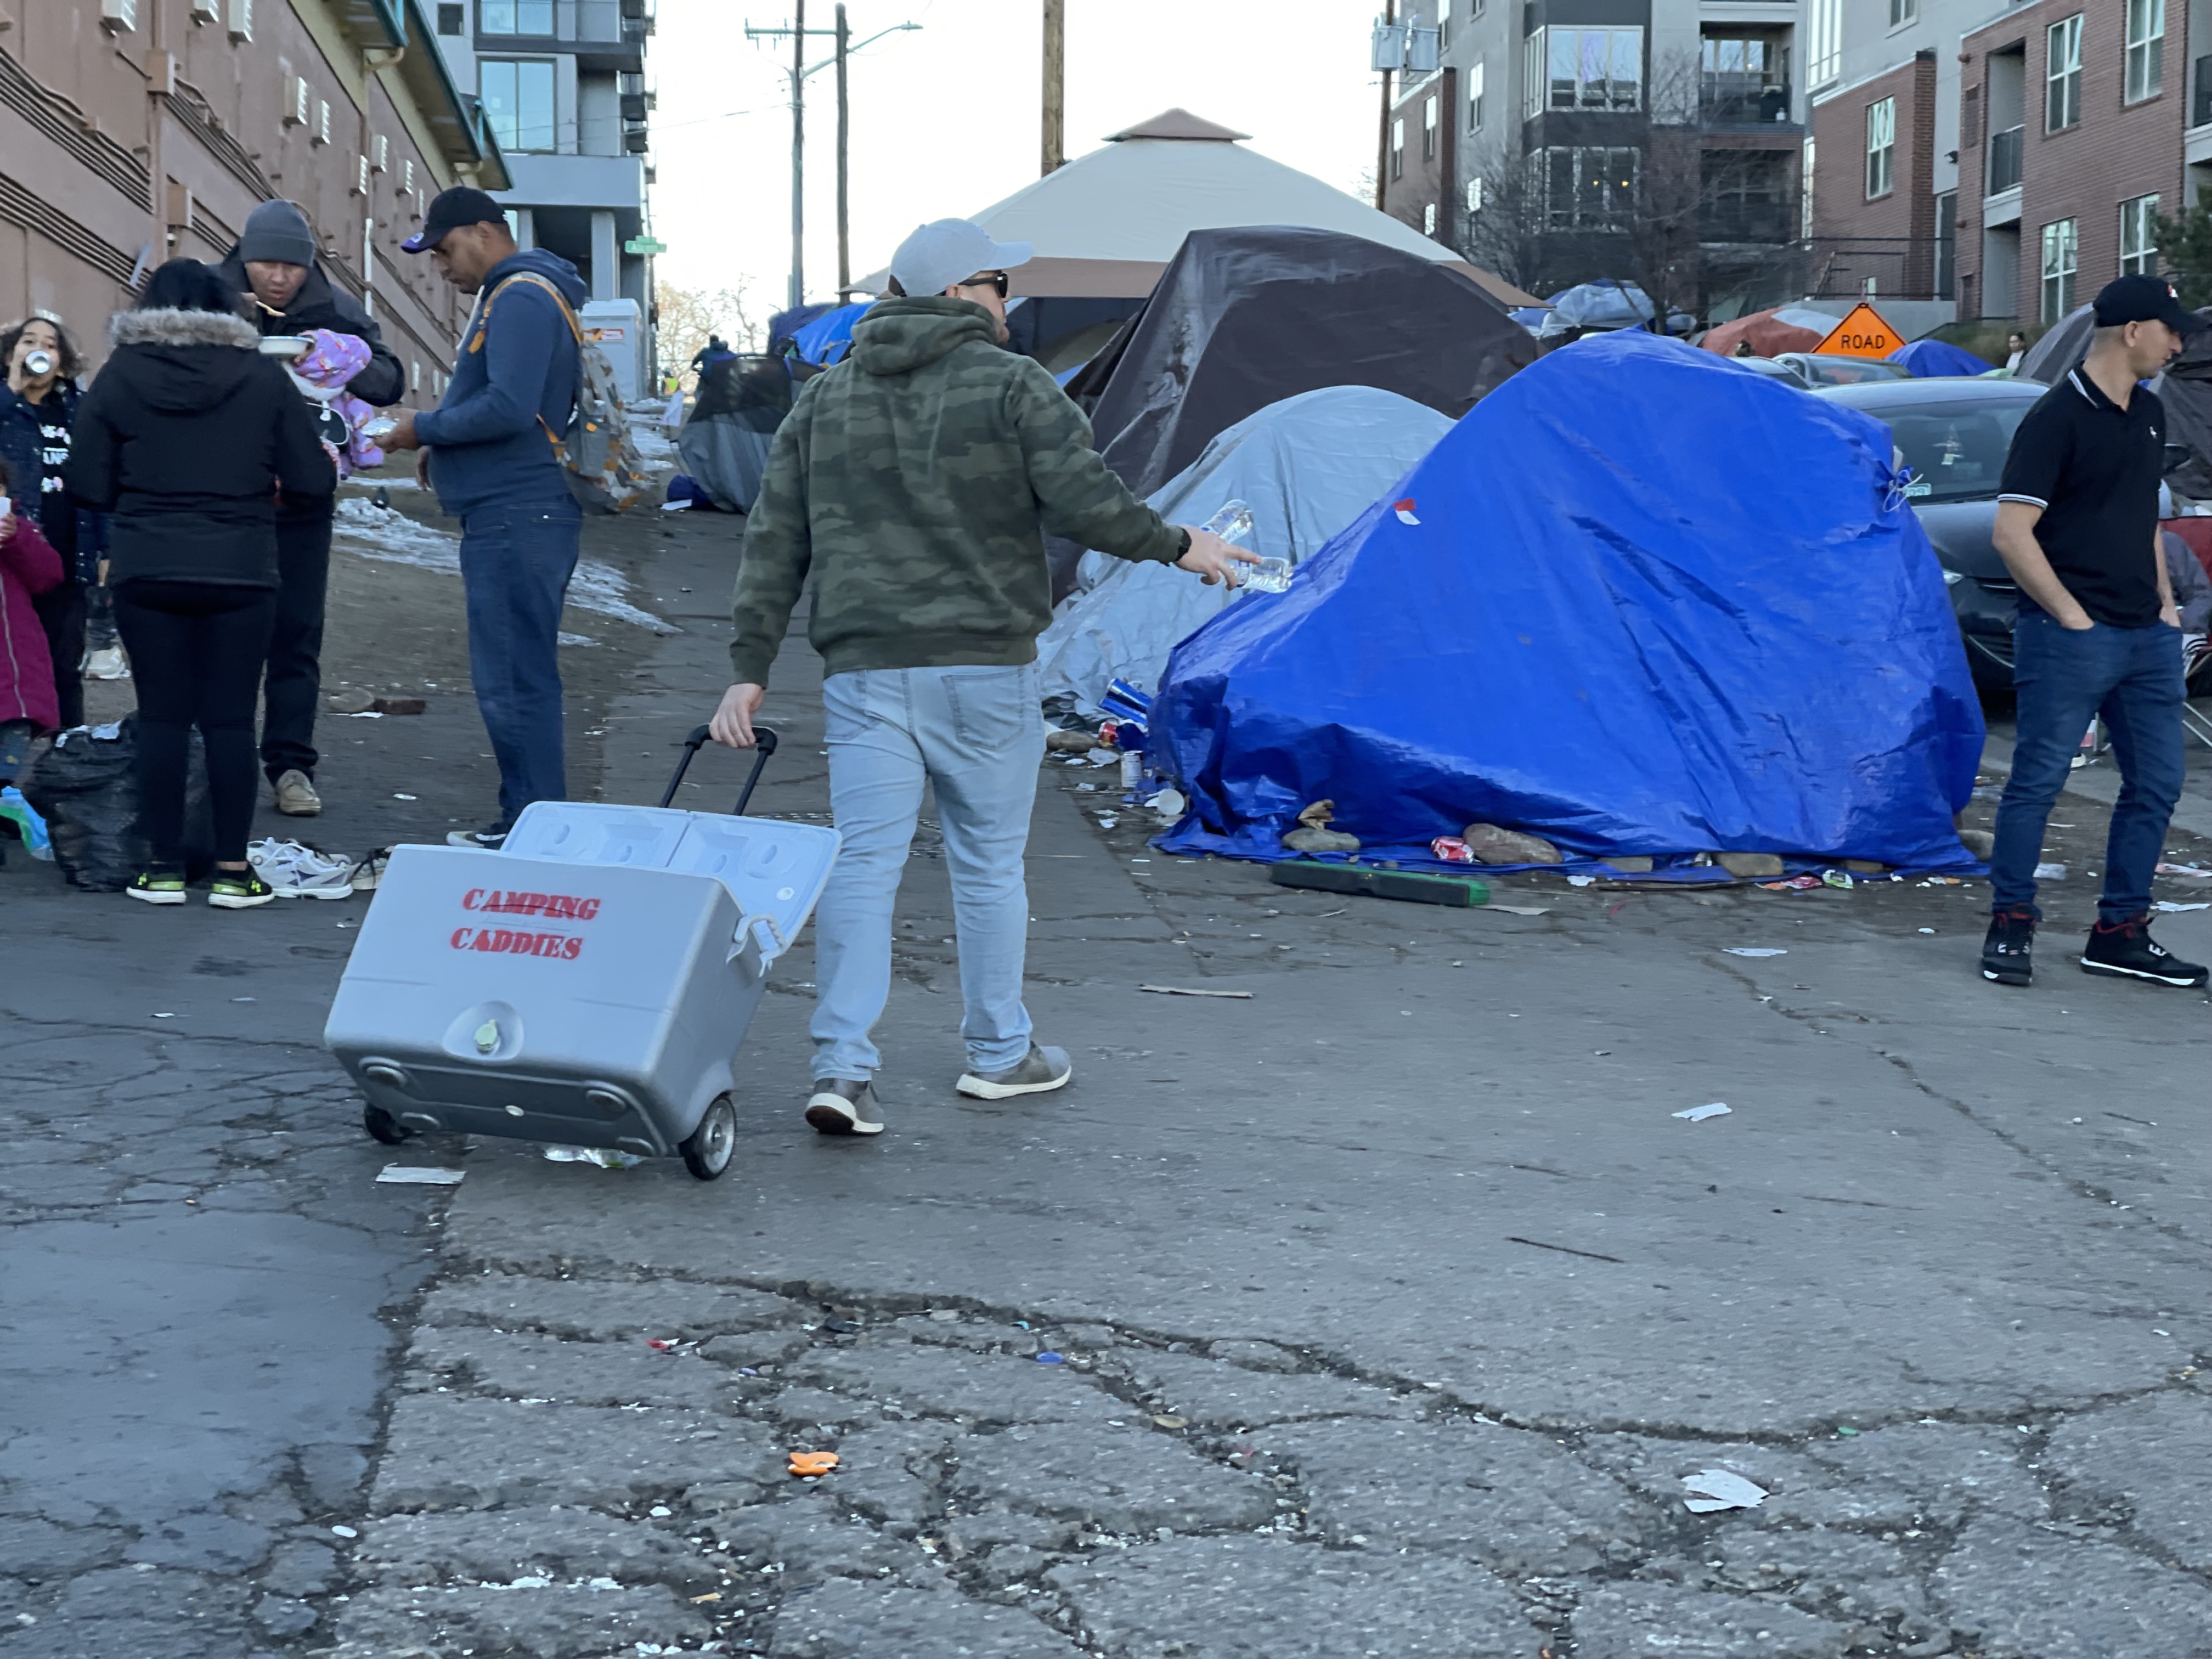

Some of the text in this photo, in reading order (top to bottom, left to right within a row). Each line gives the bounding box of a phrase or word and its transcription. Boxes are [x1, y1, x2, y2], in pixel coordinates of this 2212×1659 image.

[1841, 335, 1885, 349] ROAD
[462, 888, 601, 920] CAMPING
[450, 928, 583, 960] CADDIES
